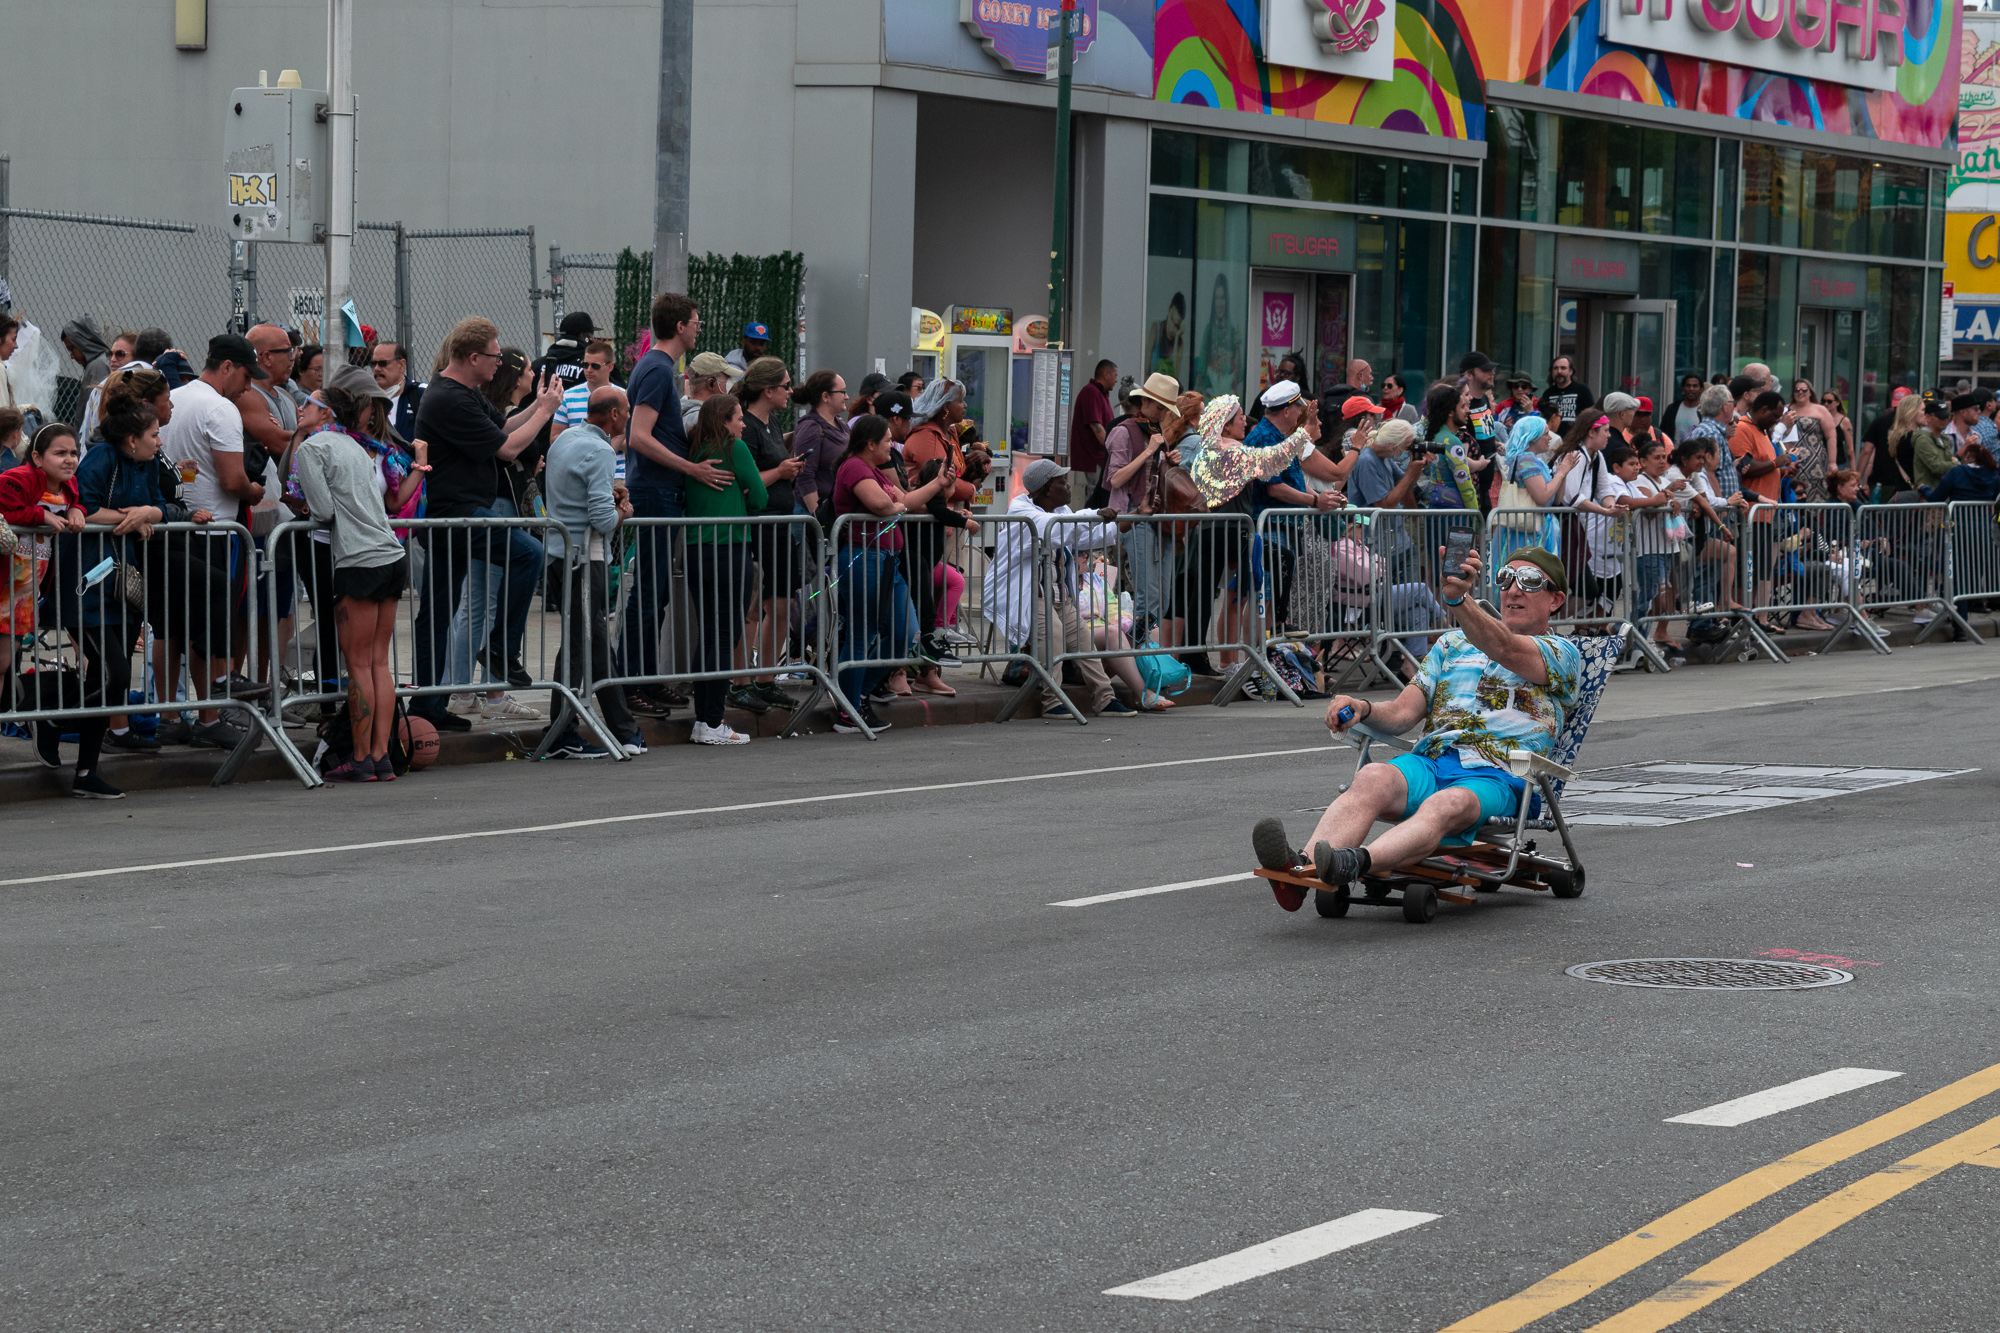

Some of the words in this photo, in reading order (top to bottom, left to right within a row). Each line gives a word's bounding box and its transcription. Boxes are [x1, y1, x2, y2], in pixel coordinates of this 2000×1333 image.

[979, 0, 1032, 26] CONEY
[1037, 7, 1091, 35] ISD
[1960, 90, 1995, 104] athan's
[294, 295, 324, 315] ABSOLU
[541, 364, 583, 379] SURITY
[973, 494, 993, 504] ASTER
